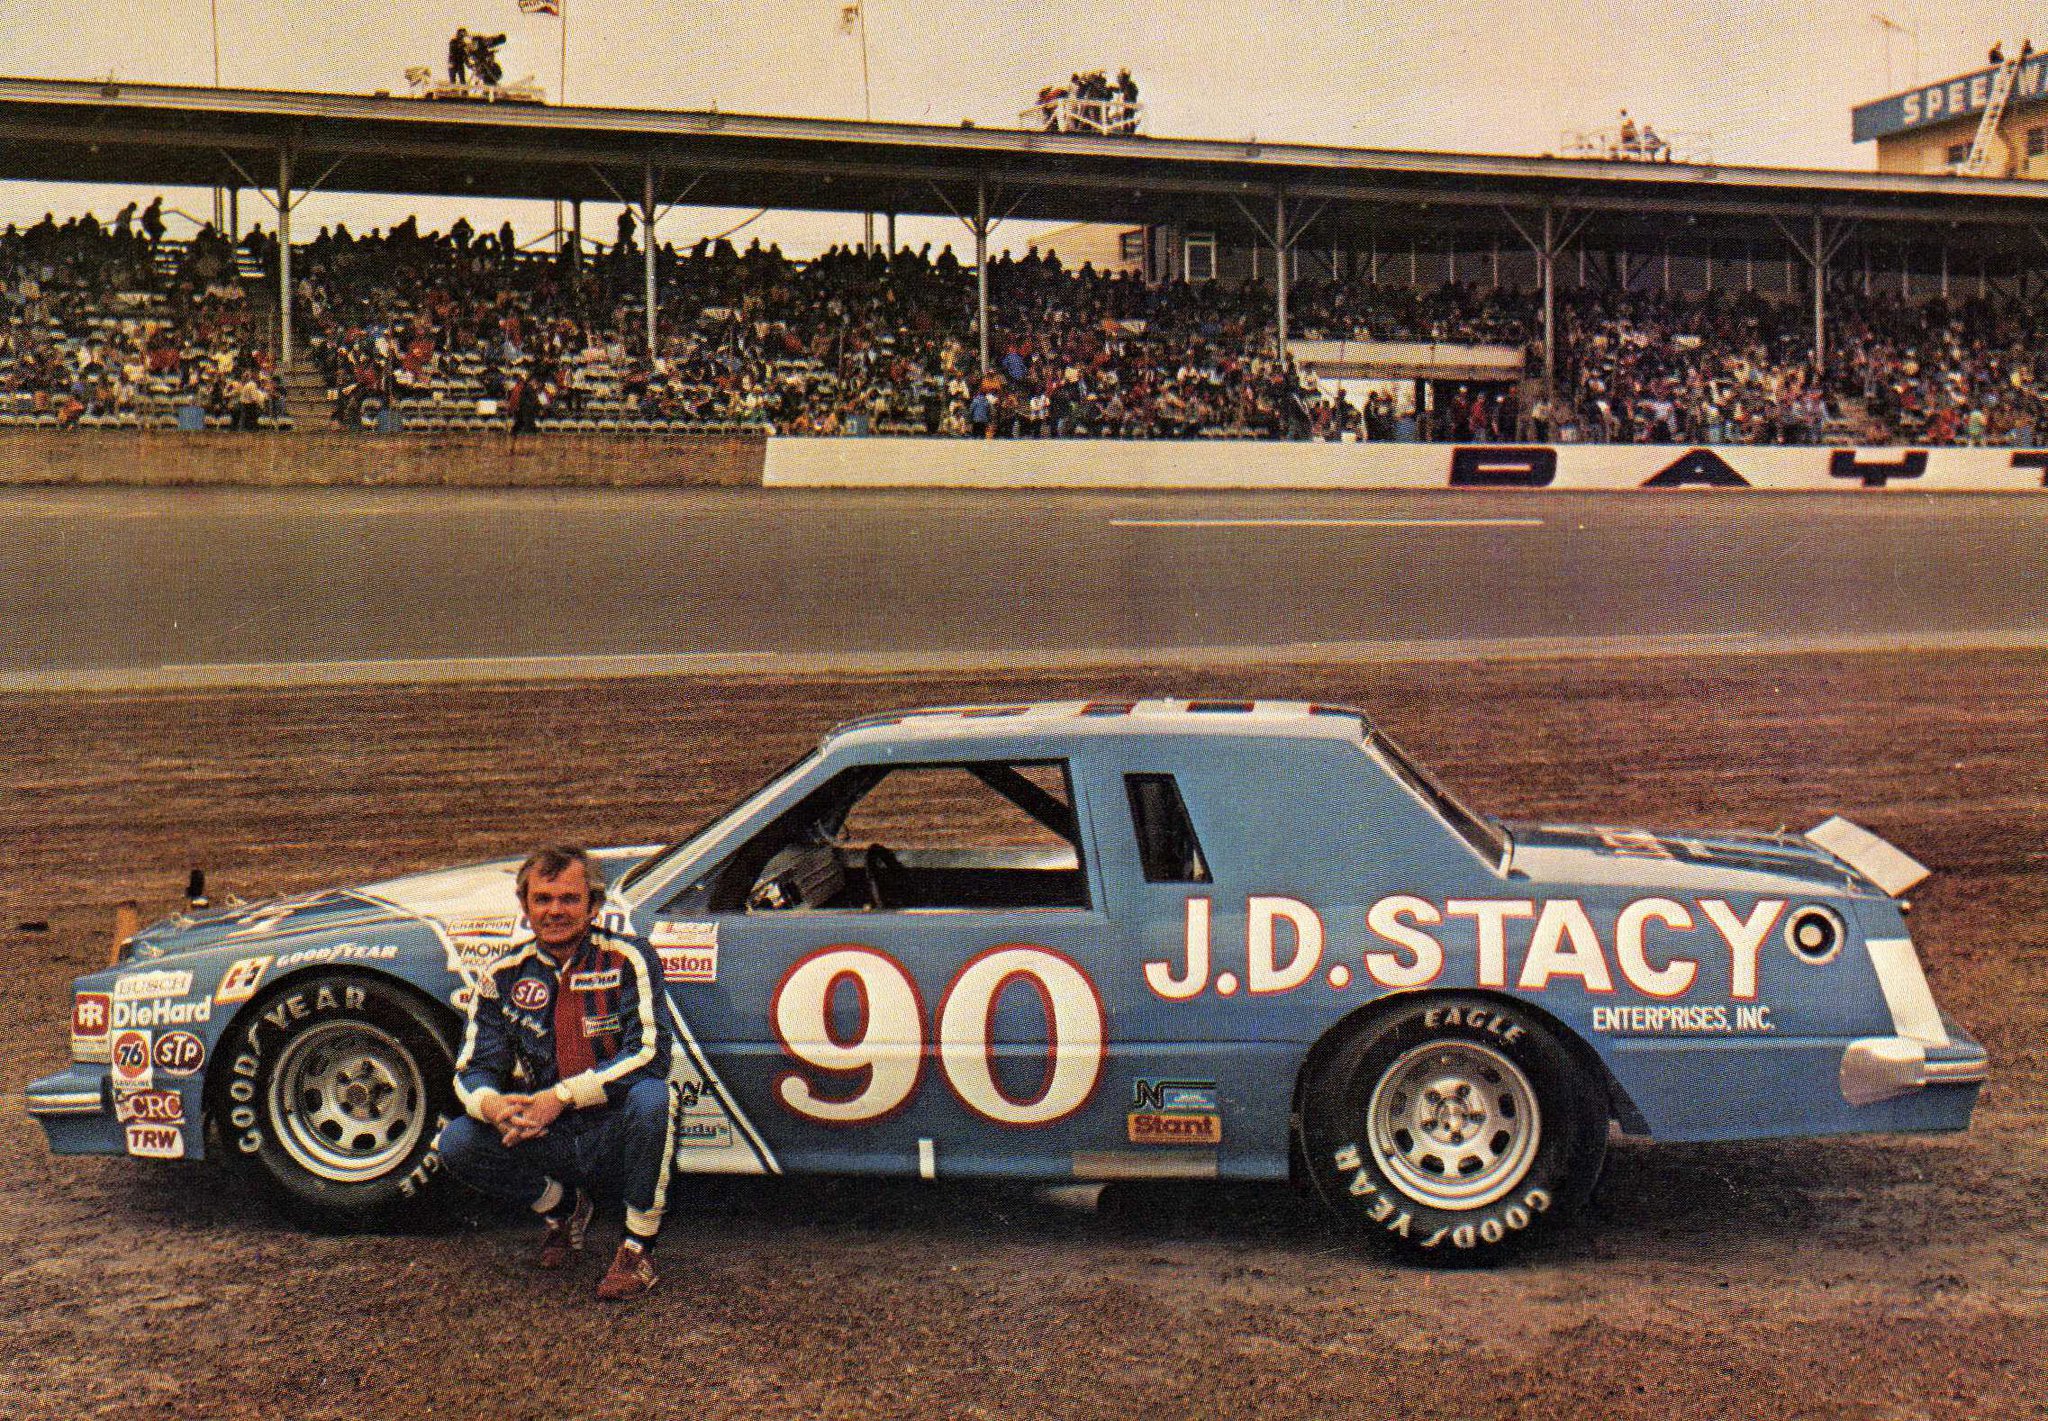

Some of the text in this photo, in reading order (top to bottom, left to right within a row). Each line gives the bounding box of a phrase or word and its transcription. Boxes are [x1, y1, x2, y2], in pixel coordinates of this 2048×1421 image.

[1143, 893, 1788, 1002] J.D. STACY
[515, 982, 547, 1004] STP
[113, 996, 212, 1028] DieHard
[1424, 1007, 1526, 1044] EAGLE
[1593, 1005, 1776, 1031] ENTERPRISES, INC.
[161, 1035, 198, 1066] STP
[769, 943, 1108, 1130] 90
[119, 1041, 145, 1068] 76
[129, 1095, 183, 1119] CRC
[129, 1130, 177, 1149] TRW
[1134, 1115, 1213, 1135] Stant
[1334, 1143, 1551, 1250] GOODYEAR
